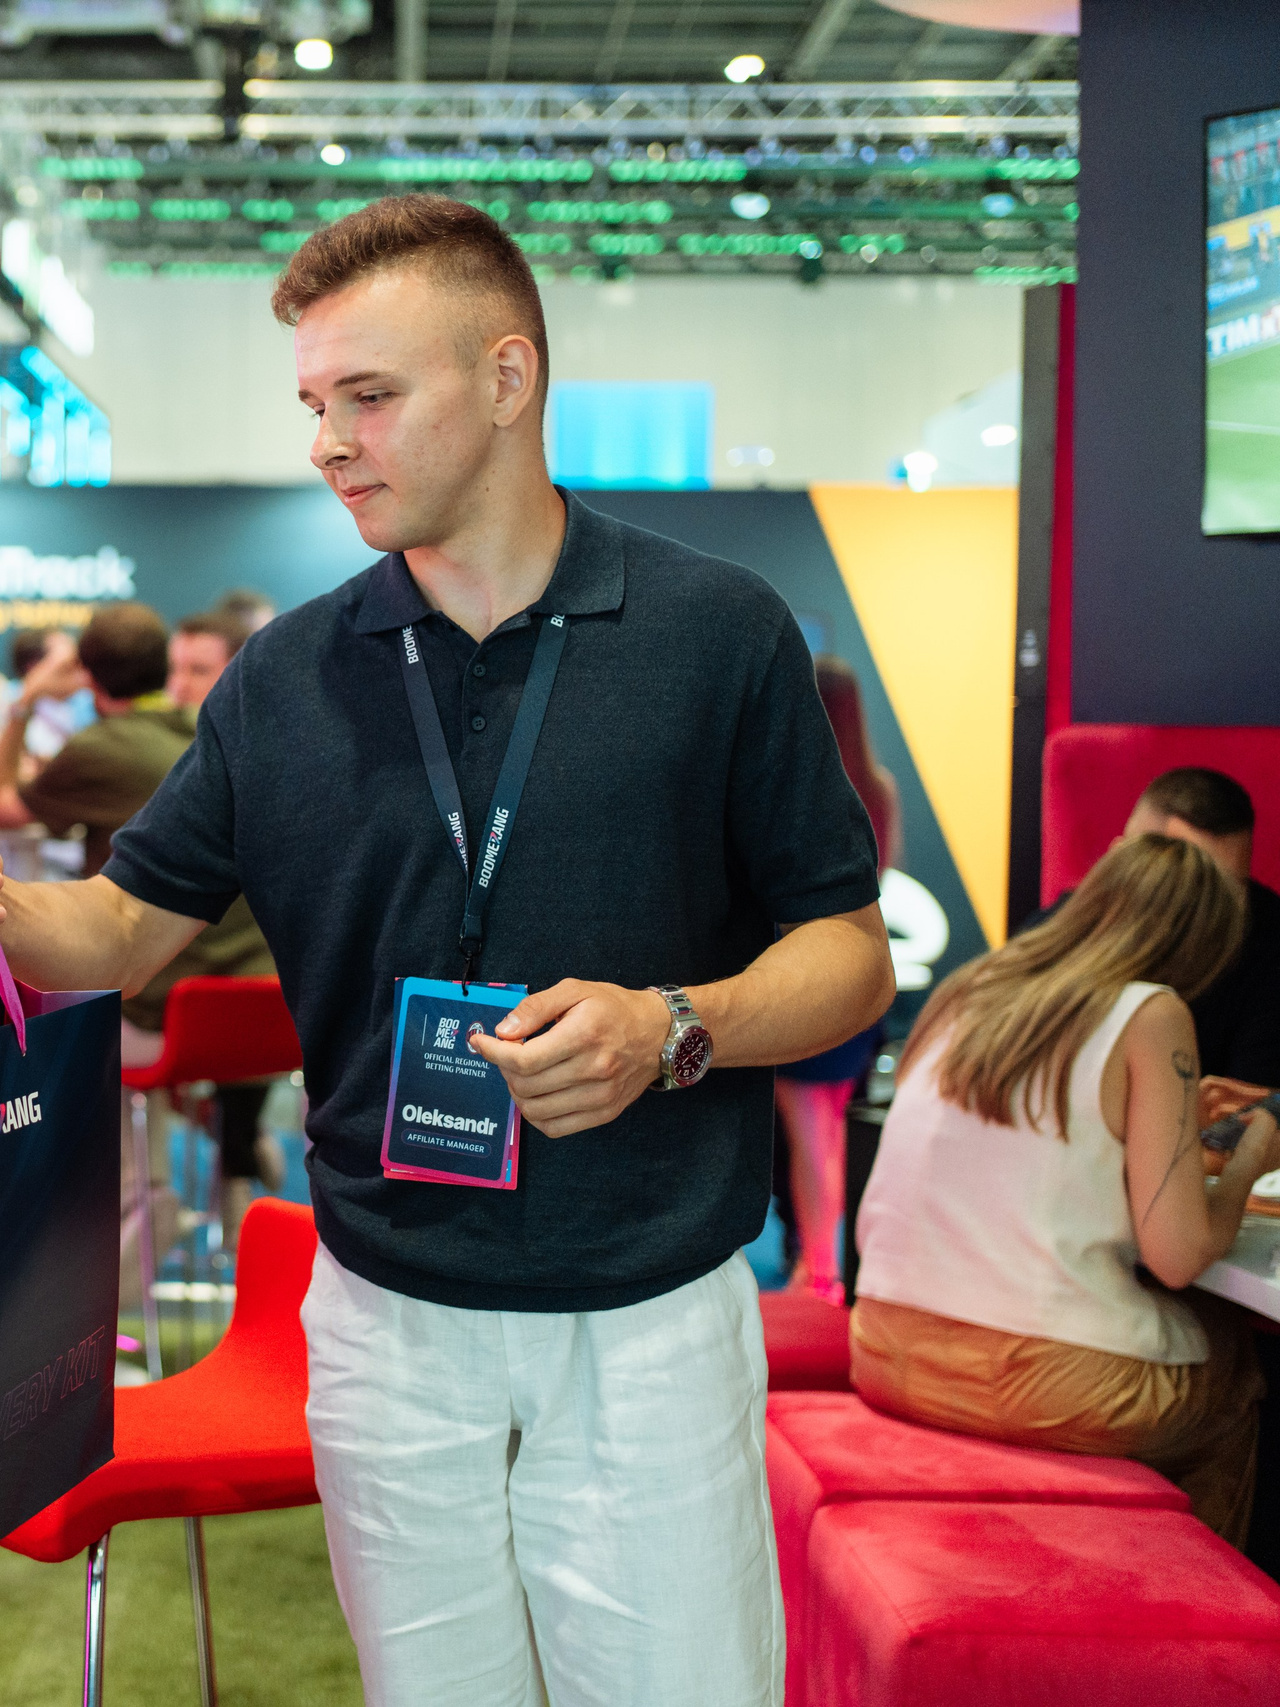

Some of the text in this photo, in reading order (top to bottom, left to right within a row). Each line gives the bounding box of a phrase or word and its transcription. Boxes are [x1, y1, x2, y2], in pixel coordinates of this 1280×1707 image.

[478, 806, 510, 888] BOOMERANG
[423, 1052, 490, 1070] OFFICIAL REGIONAL
[425, 1062, 487, 1078] BETTING PARTNER
[402, 1104, 498, 1136] Oleksandr
[407, 1133, 485, 1153] AFFILIATE MANAGER
[60, 1324, 106, 1400] KIT
